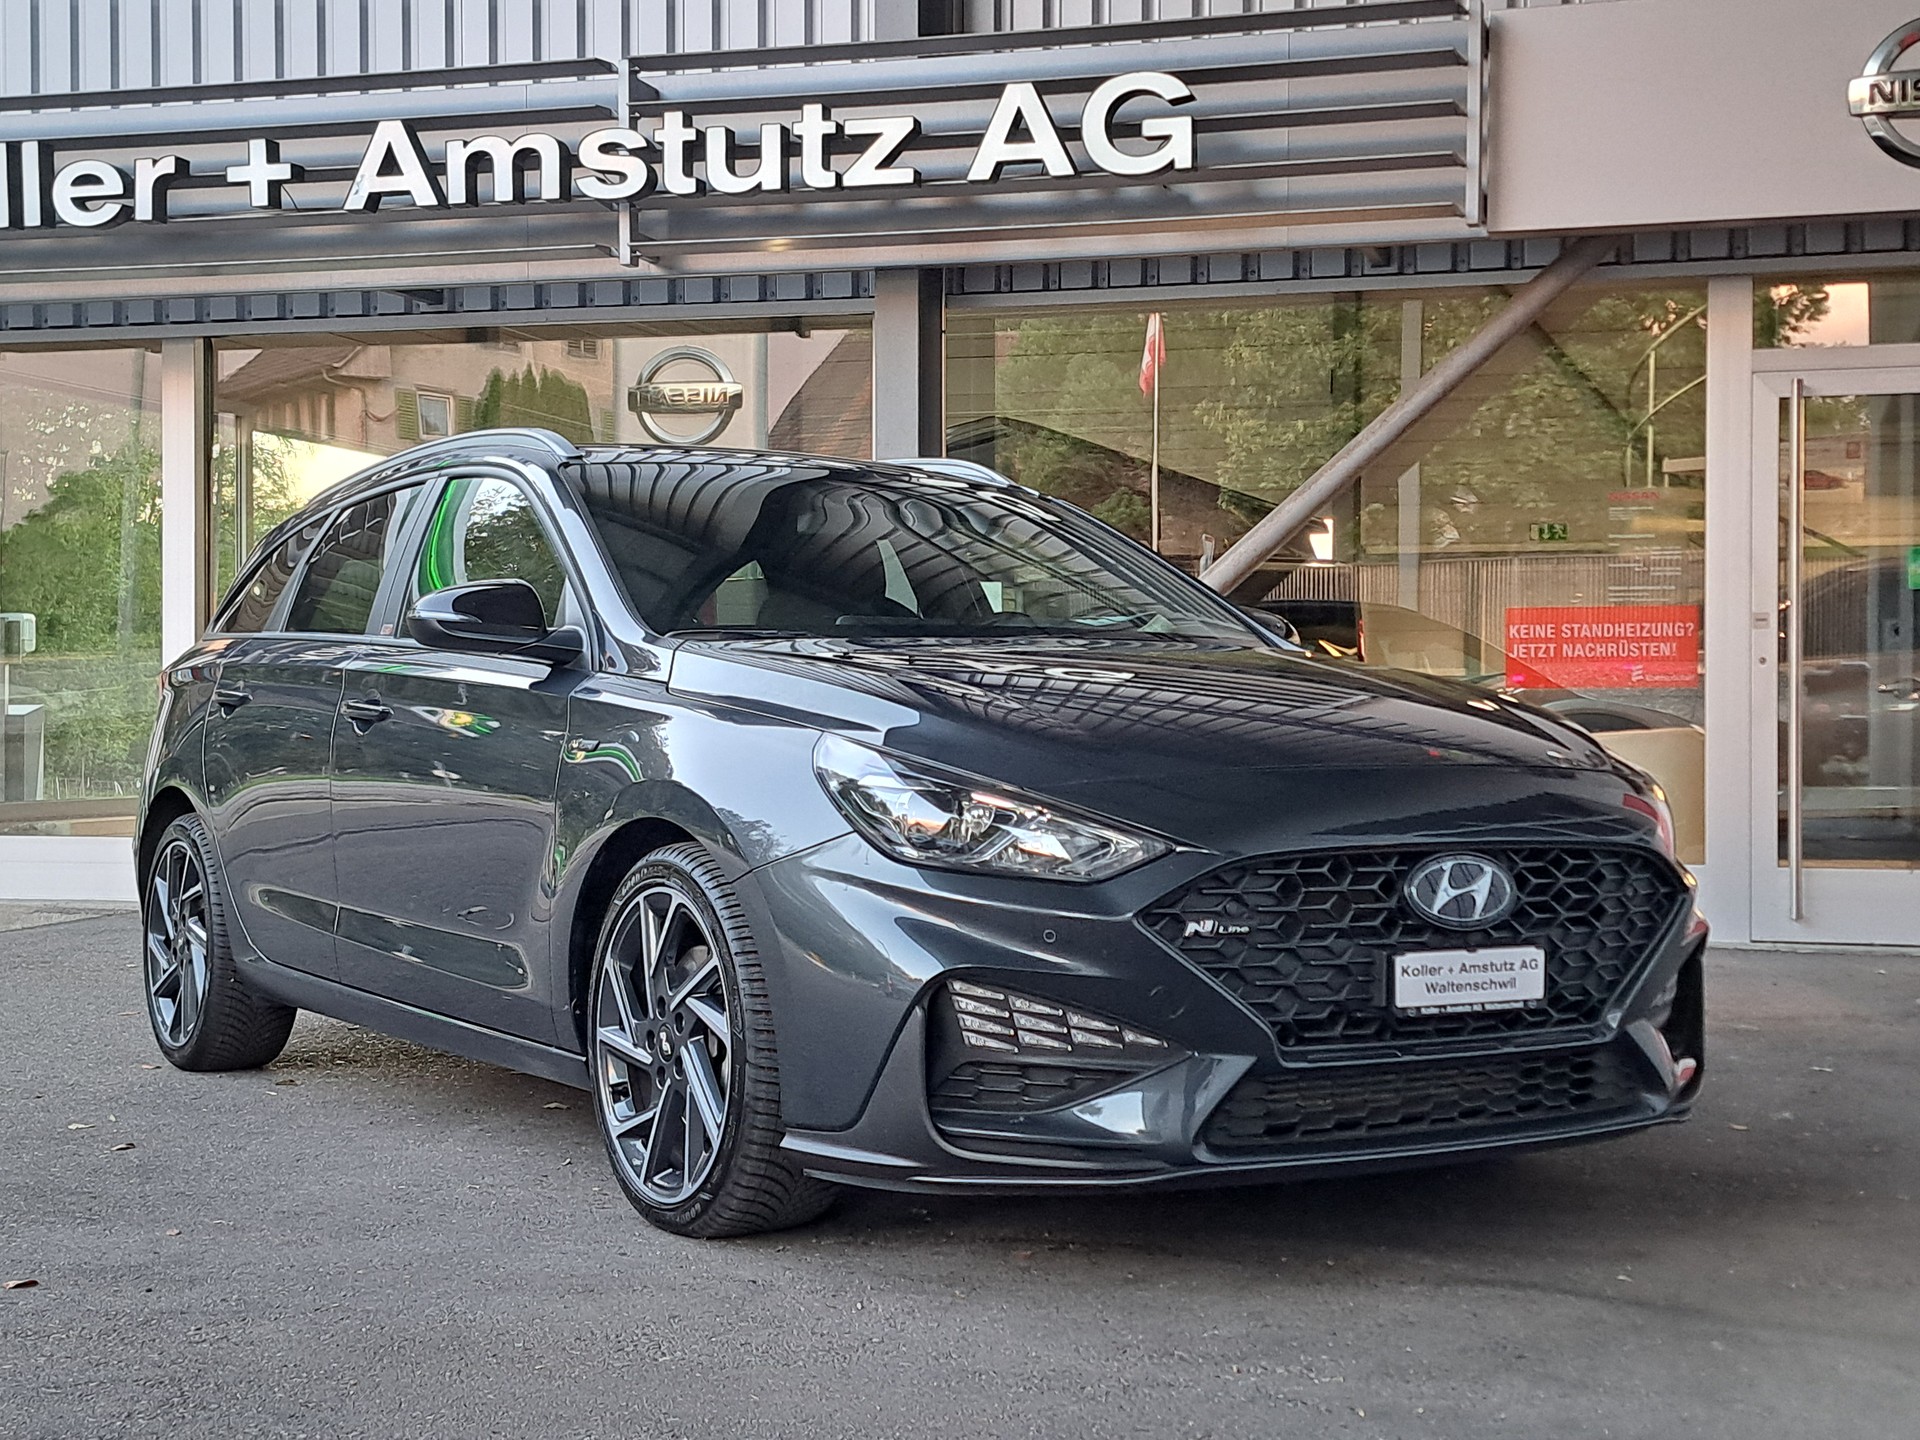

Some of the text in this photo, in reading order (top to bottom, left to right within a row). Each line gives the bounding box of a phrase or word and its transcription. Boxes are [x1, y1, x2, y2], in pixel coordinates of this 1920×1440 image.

[226, 137, 292, 208] +
[343, 102, 916, 212] Amstutz
[966, 71, 1197, 182] AG
[1509, 622, 1695, 639] KEINE STANDHEIZUNG?
[1509, 639, 1677, 659] JETZT NACHRÜSTEN!
[1401, 964, 1444, 978] Koller
[1459, 960, 1515, 975] Amstutz
[1519, 958, 1539, 971] AG
[1425, 977, 1517, 994] Waltenschwil
